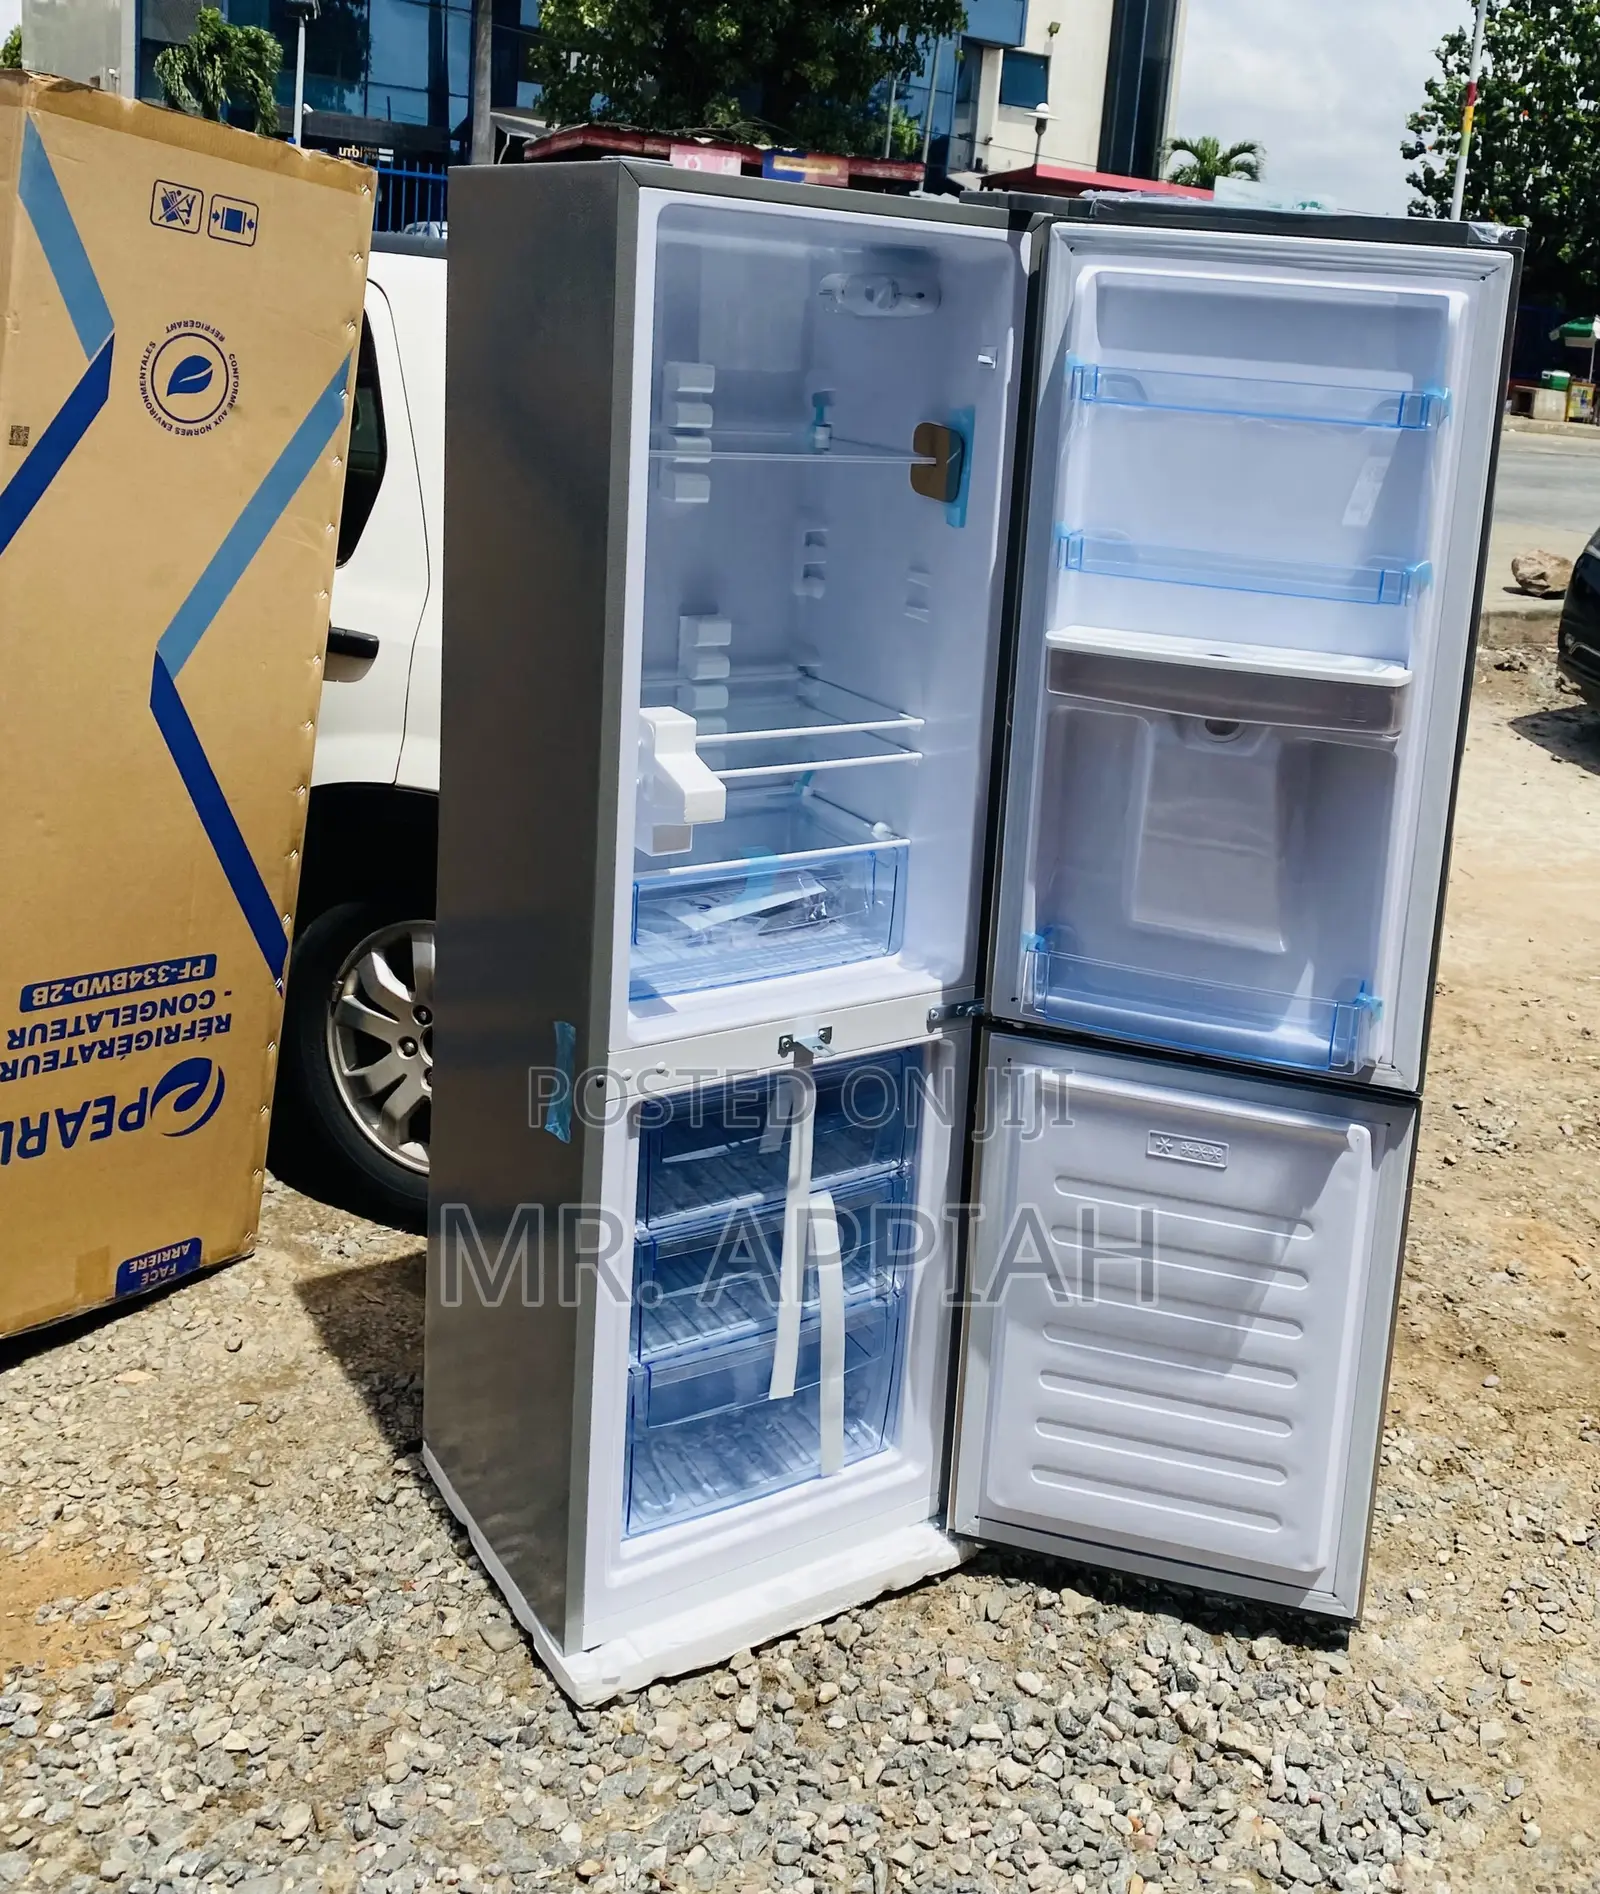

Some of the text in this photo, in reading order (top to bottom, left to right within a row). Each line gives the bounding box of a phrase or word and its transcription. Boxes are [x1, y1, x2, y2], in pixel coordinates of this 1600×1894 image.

[139, 340, 240, 437] CONFORME AUX NORMES ENVIRONMENTALES
[32, 958, 207, 1007] PF-334BWD-2B
[0, 1013, 232, 1082] RÉFRIGÉRATEUR
[7, 989, 216, 1050] CONGELATEUR
[0, 1086, 149, 1166] PEARL
[140, 1262, 178, 1286] FACE
